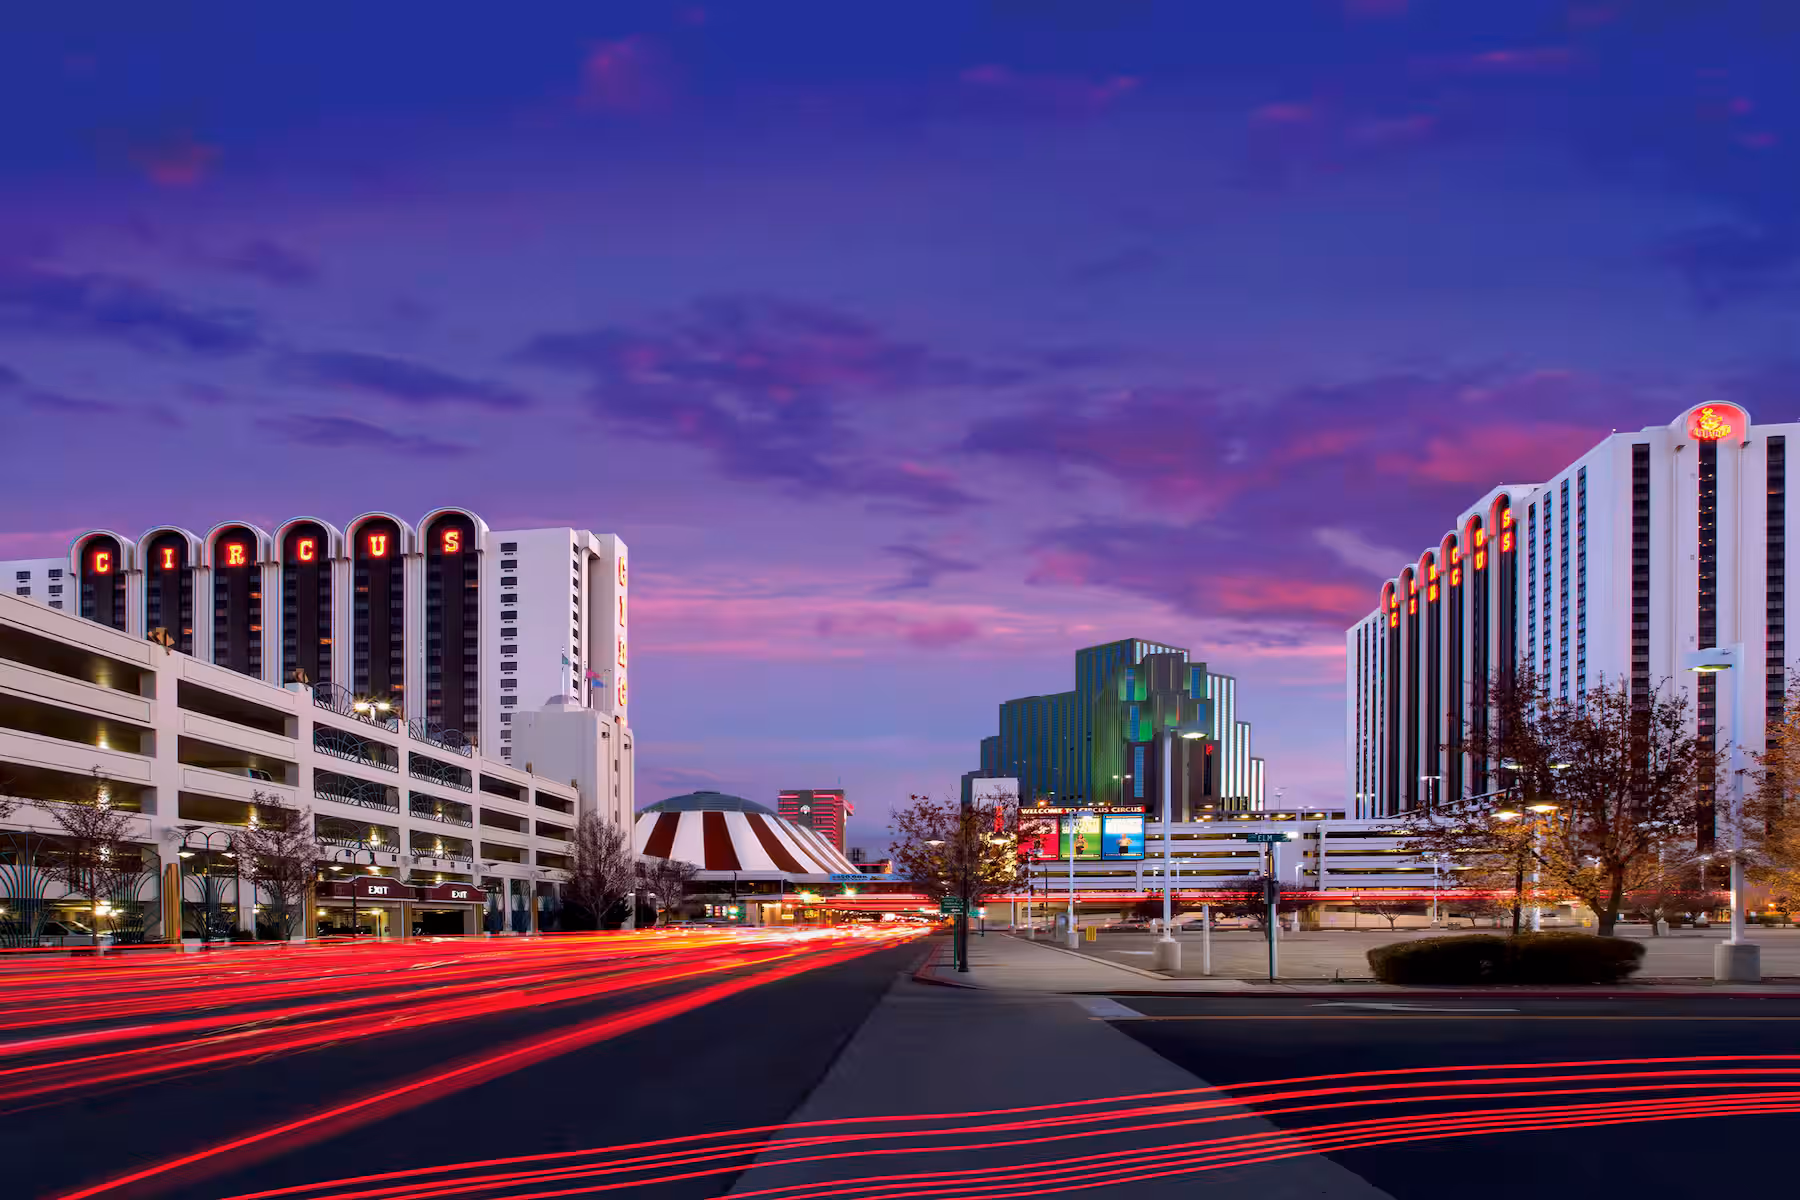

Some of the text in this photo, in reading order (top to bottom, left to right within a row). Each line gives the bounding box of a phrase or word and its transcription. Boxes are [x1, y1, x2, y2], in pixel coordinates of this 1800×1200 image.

[94, 531, 460, 573] CIRCUS
[1021, 807, 1063, 815] WELCOME
[1257, 834, 1273, 842] ELM
[368, 885, 389, 895] EXIT
[451, 890, 468, 899] EXIT
